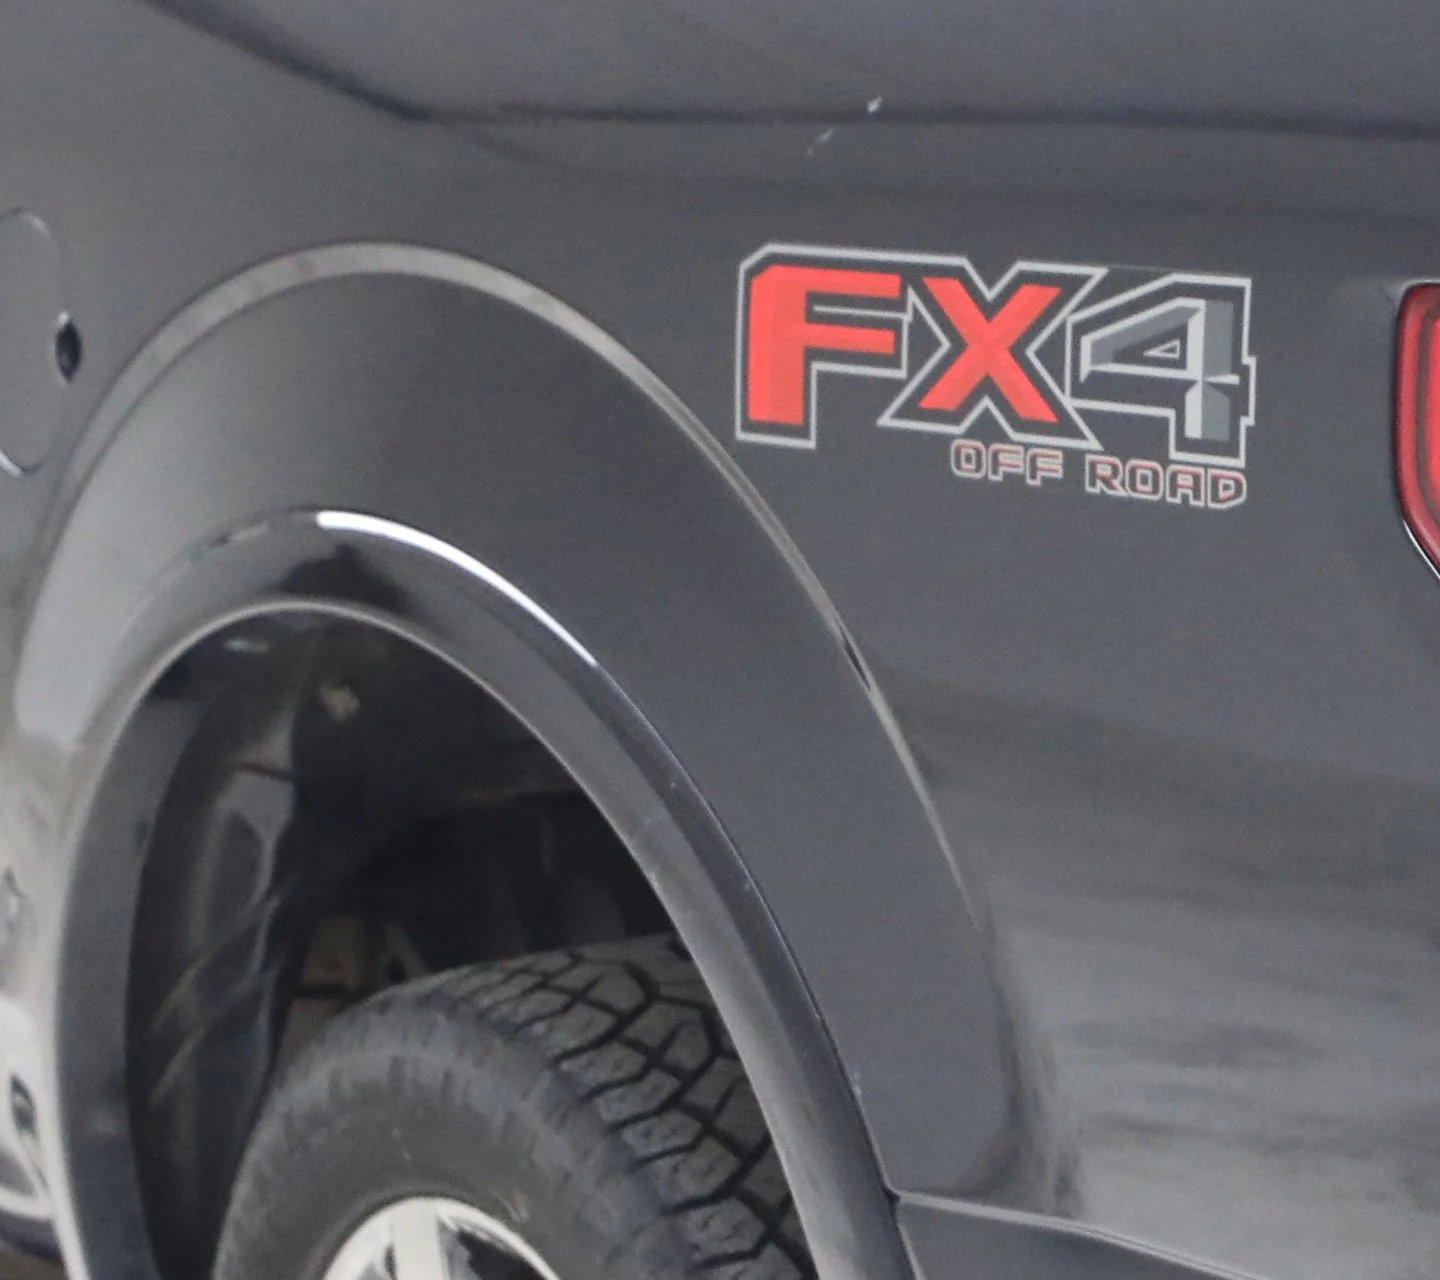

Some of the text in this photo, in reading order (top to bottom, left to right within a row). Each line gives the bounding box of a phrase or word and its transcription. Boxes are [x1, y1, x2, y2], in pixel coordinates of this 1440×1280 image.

[736, 243, 1256, 467] FX4
[951, 439, 1247, 510] OFF ROAD
